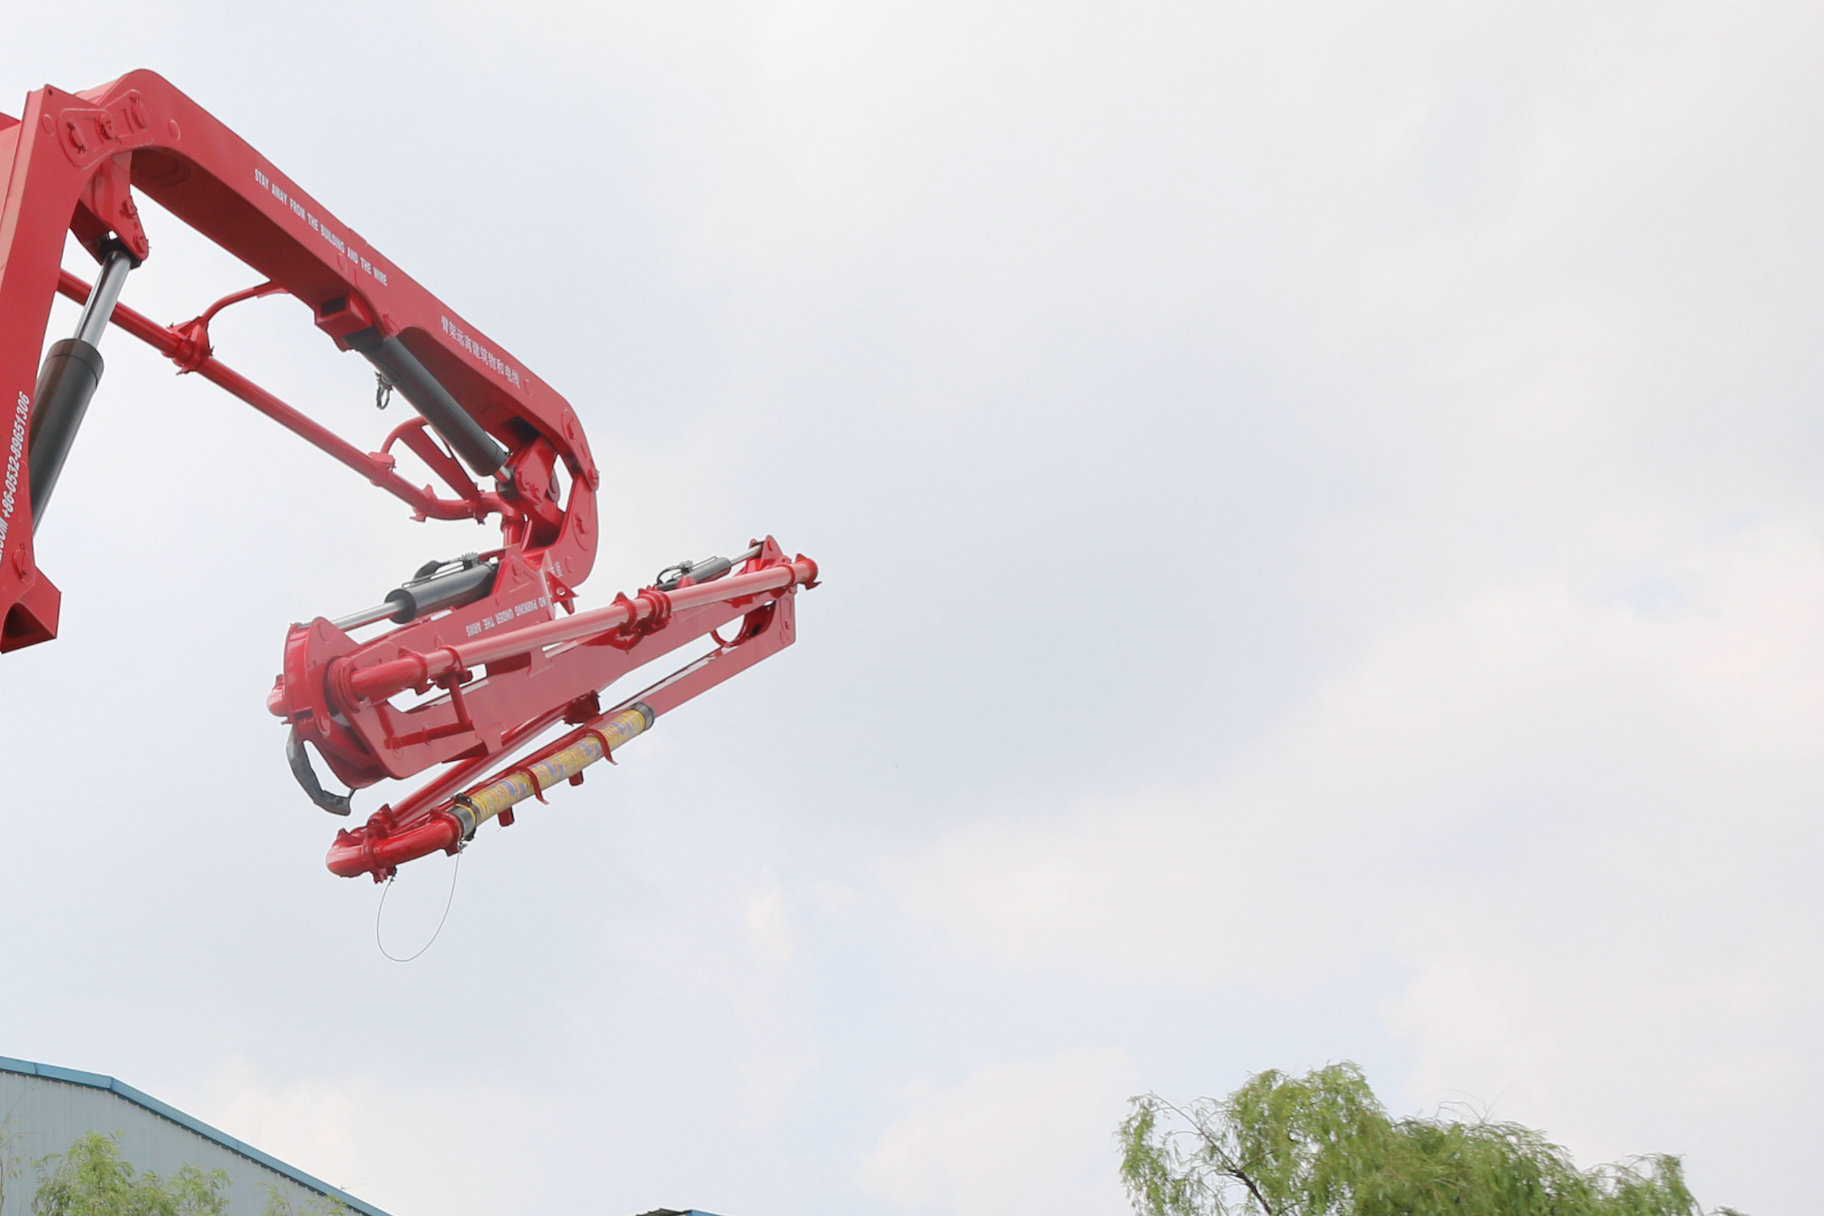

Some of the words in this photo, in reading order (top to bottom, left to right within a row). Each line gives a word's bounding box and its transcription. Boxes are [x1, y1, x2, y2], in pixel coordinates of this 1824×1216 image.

[254, 168, 269, 190] STAY
[272, 183, 289, 206] AWAY
[289, 197, 307, 221] FROM
[307, 213, 320, 232] THE
[320, 223, 346, 254] BUILDING
[347, 246, 359, 265] AND
[360, 255, 372, 275] THE
[373, 265, 389, 287] WIRE
[3, 390, 31, 519] +86-0532-89651306
